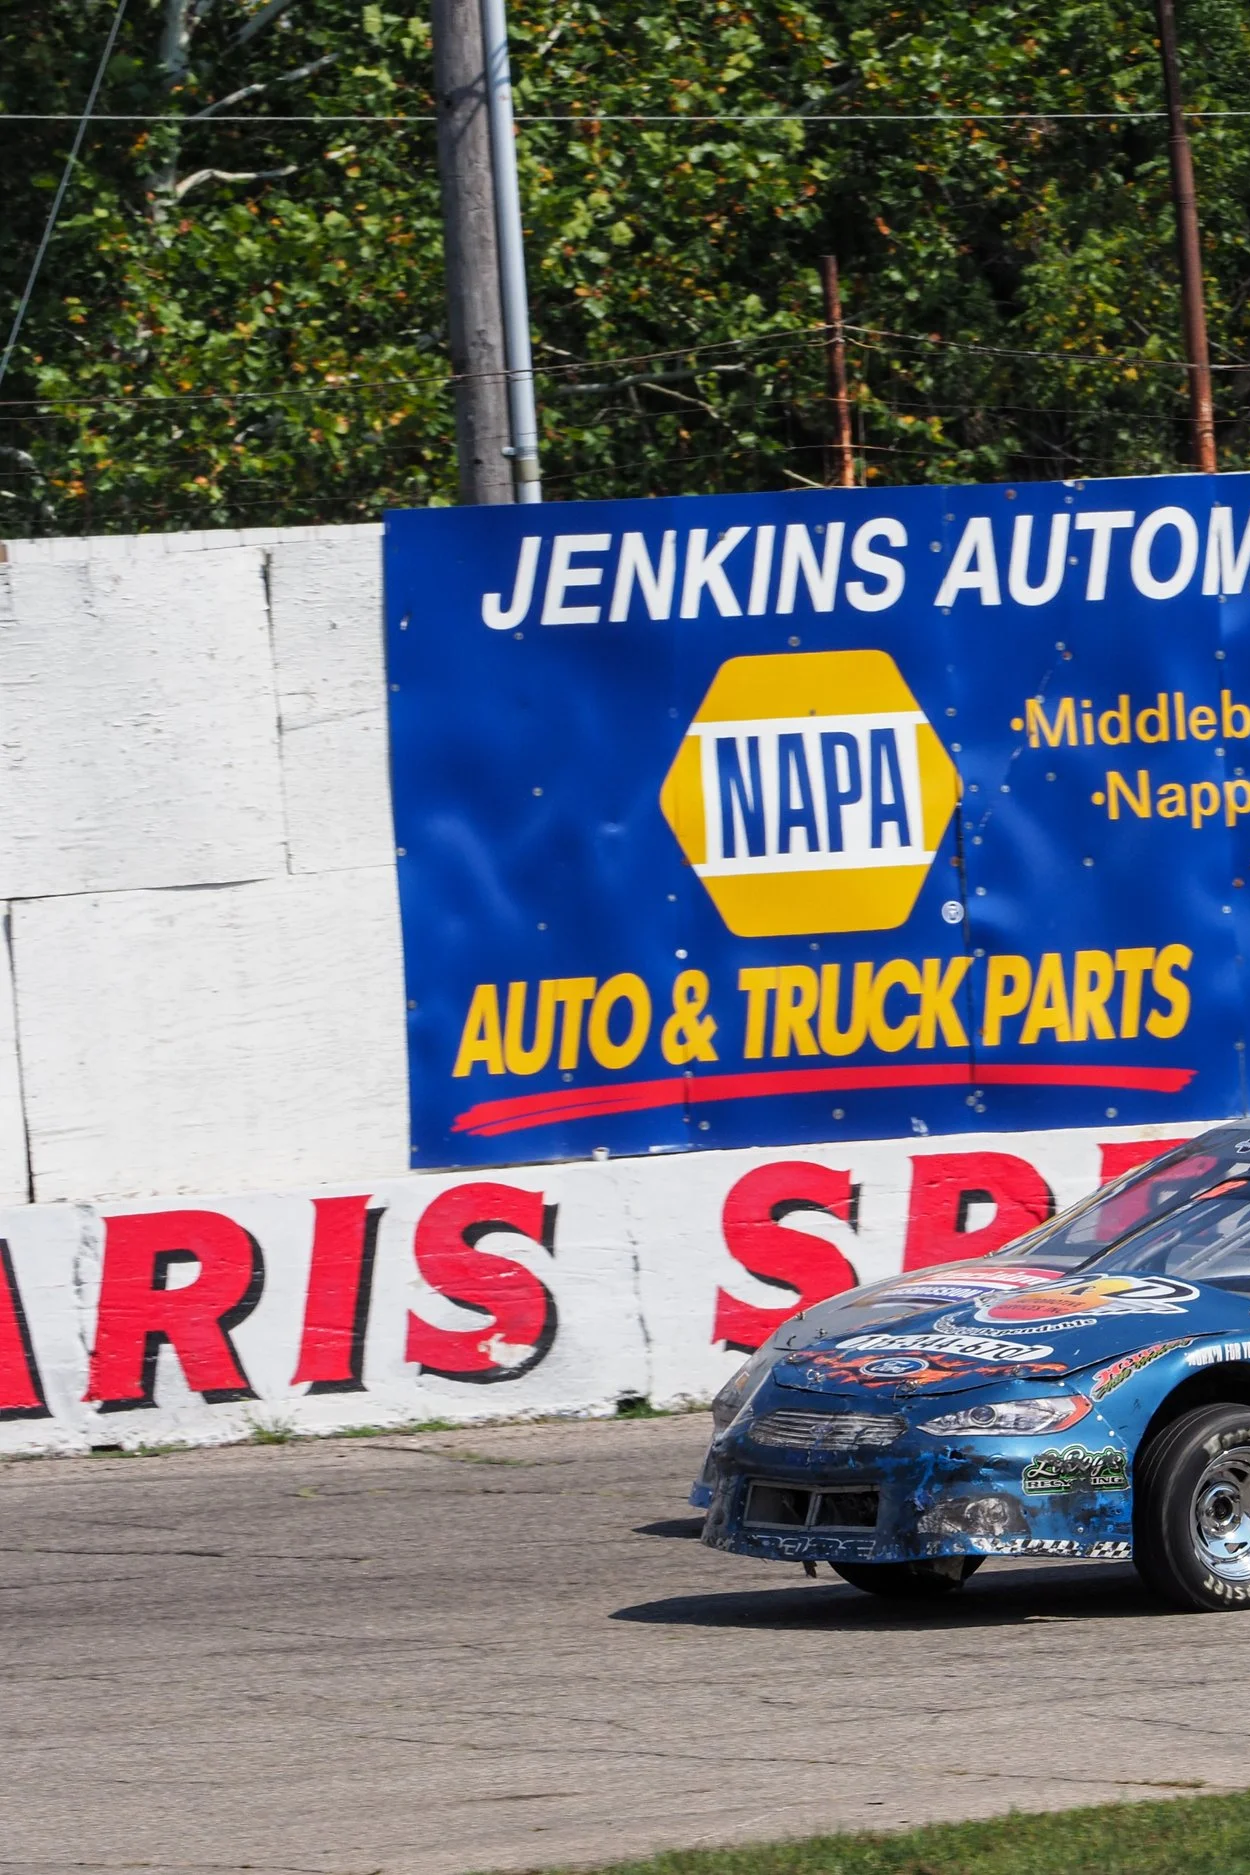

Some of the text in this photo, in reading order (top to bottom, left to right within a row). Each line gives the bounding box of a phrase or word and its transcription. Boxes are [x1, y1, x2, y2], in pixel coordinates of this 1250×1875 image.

[483, 517, 907, 630] JENKINS
[714, 727, 911, 859] NAPA
[453, 943, 1192, 1077] AUTO & TRUCK PARTS
[0, 1182, 555, 1416] RIS
[1025, 1476, 1125, 1490] RECYING
